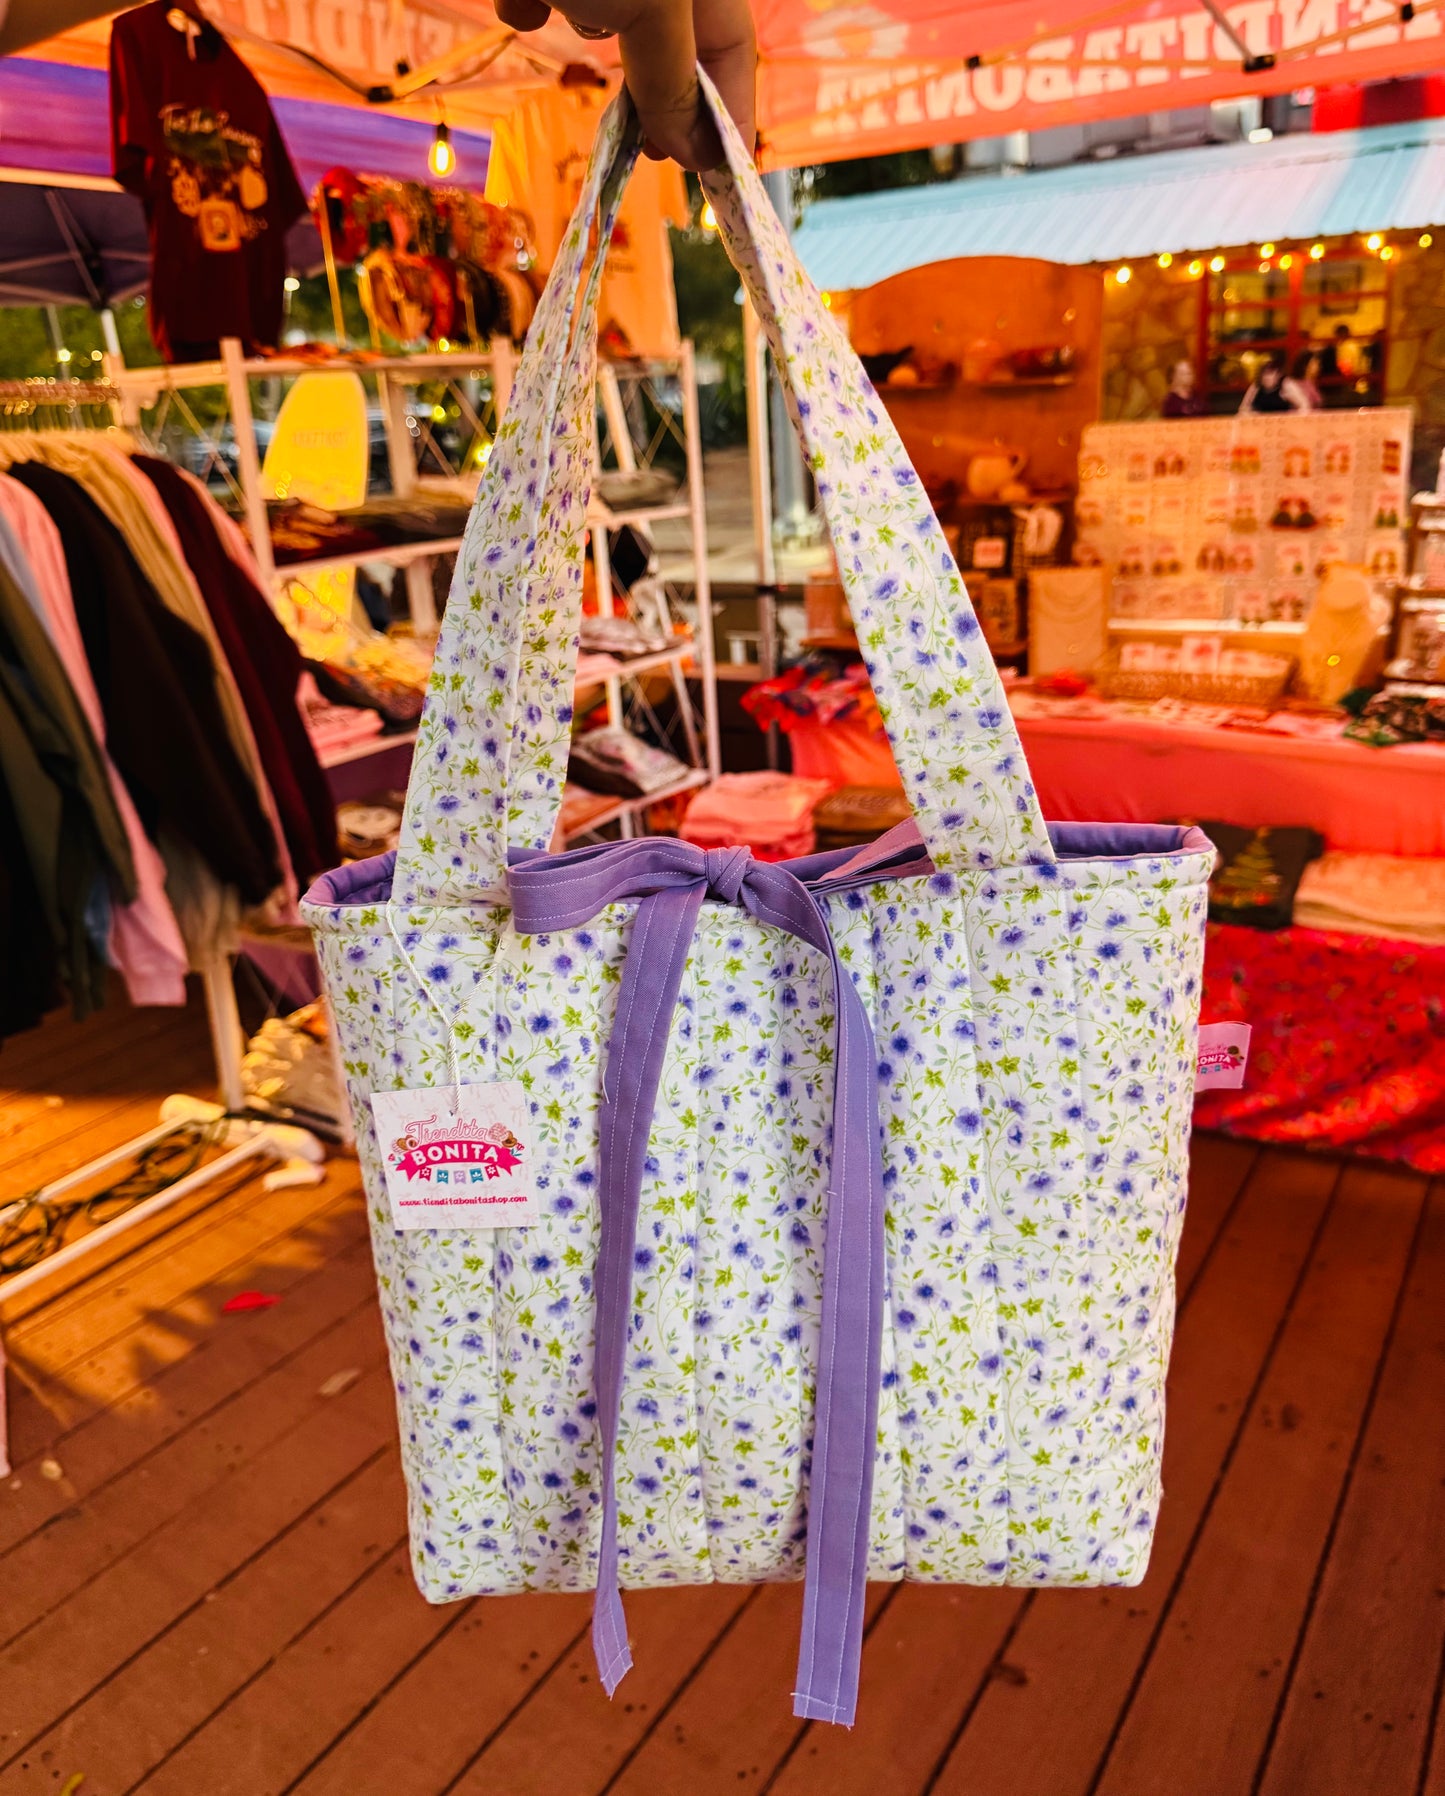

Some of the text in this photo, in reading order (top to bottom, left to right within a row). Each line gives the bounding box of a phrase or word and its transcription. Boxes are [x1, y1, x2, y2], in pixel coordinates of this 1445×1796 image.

[1199, 1054, 1231, 1065] ONITA
[405, 1115, 490, 1145] Tiendita
[411, 1143, 498, 1166] BONITA
[399, 1195, 528, 1207] www.tienditabonitashop.com
